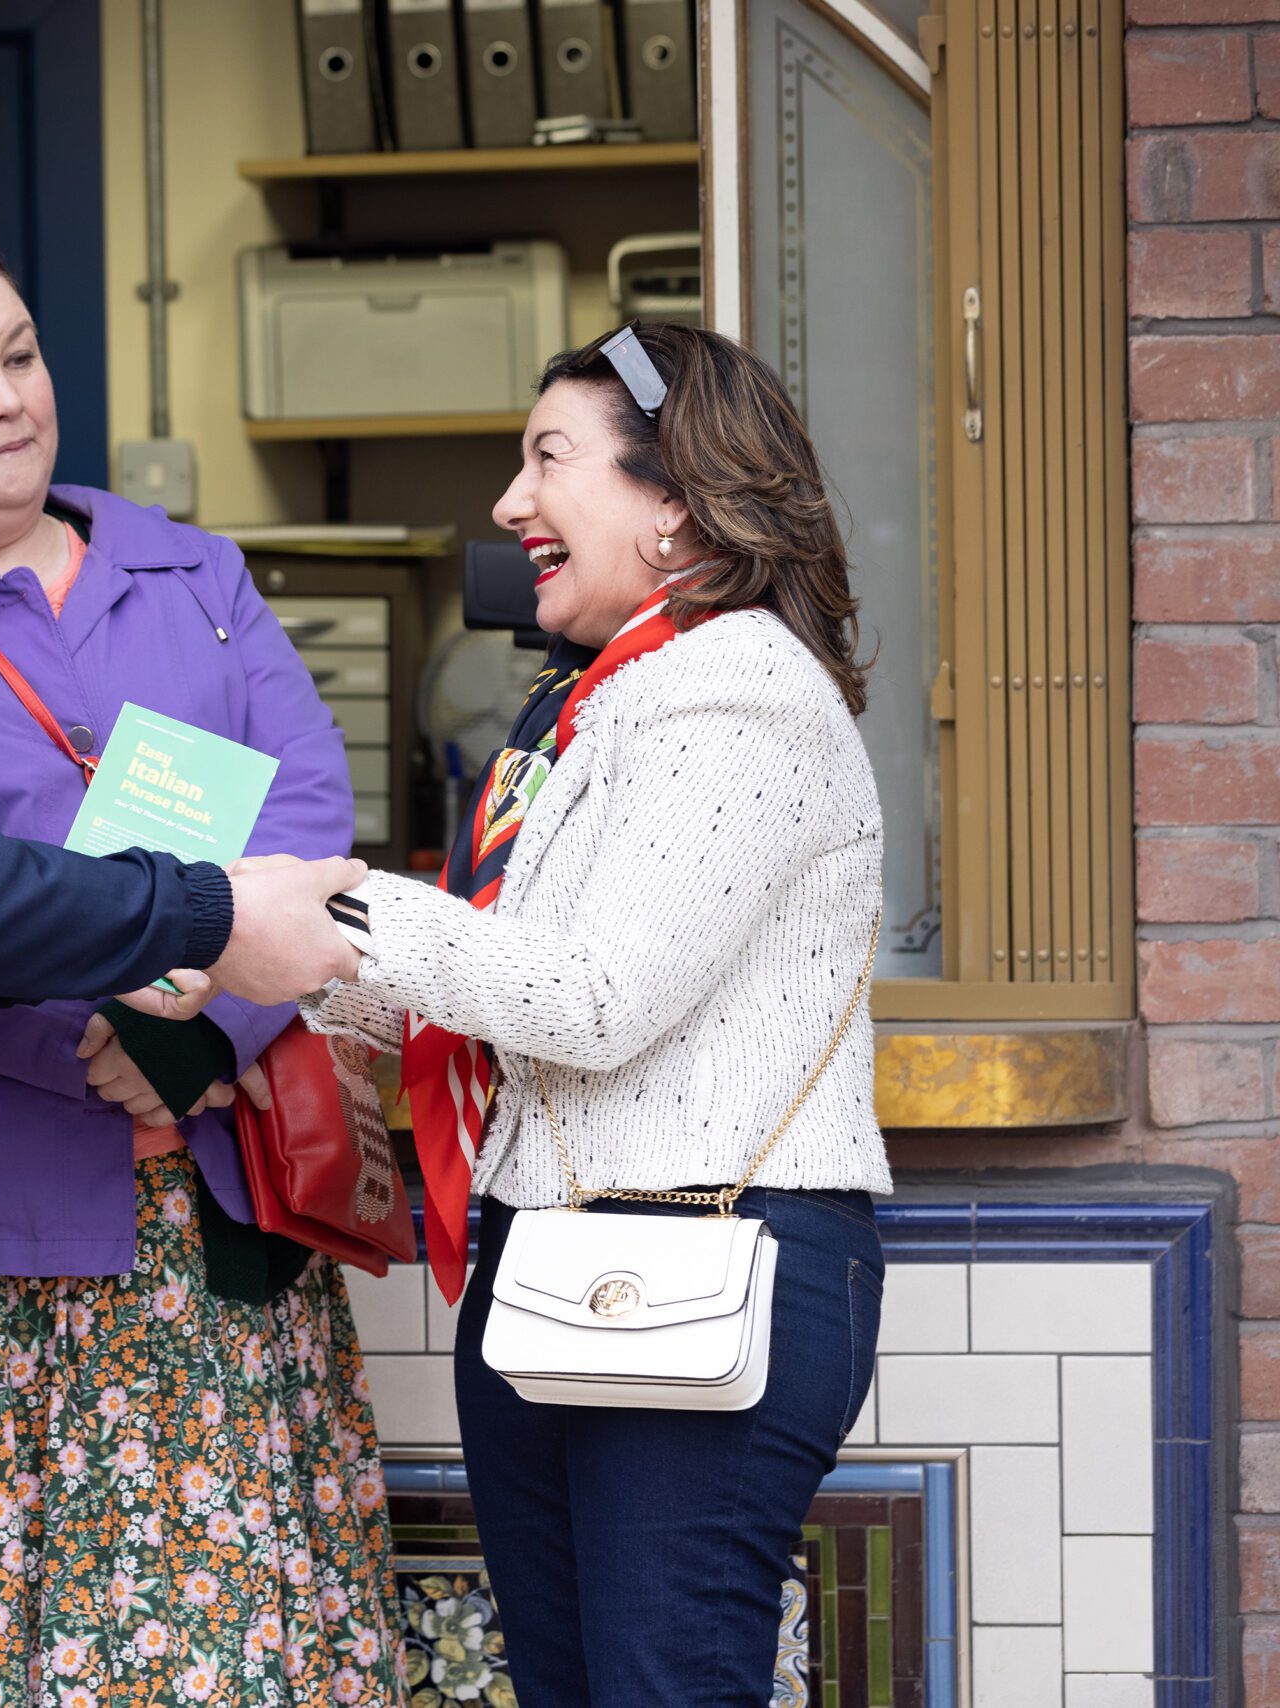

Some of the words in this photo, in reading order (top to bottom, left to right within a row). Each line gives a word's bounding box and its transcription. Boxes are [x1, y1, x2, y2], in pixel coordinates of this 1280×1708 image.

[135, 741, 173, 768] Easy
[127, 756, 204, 802] Italian
[119, 779, 172, 809] Phrase
[172, 800, 215, 826] Book
